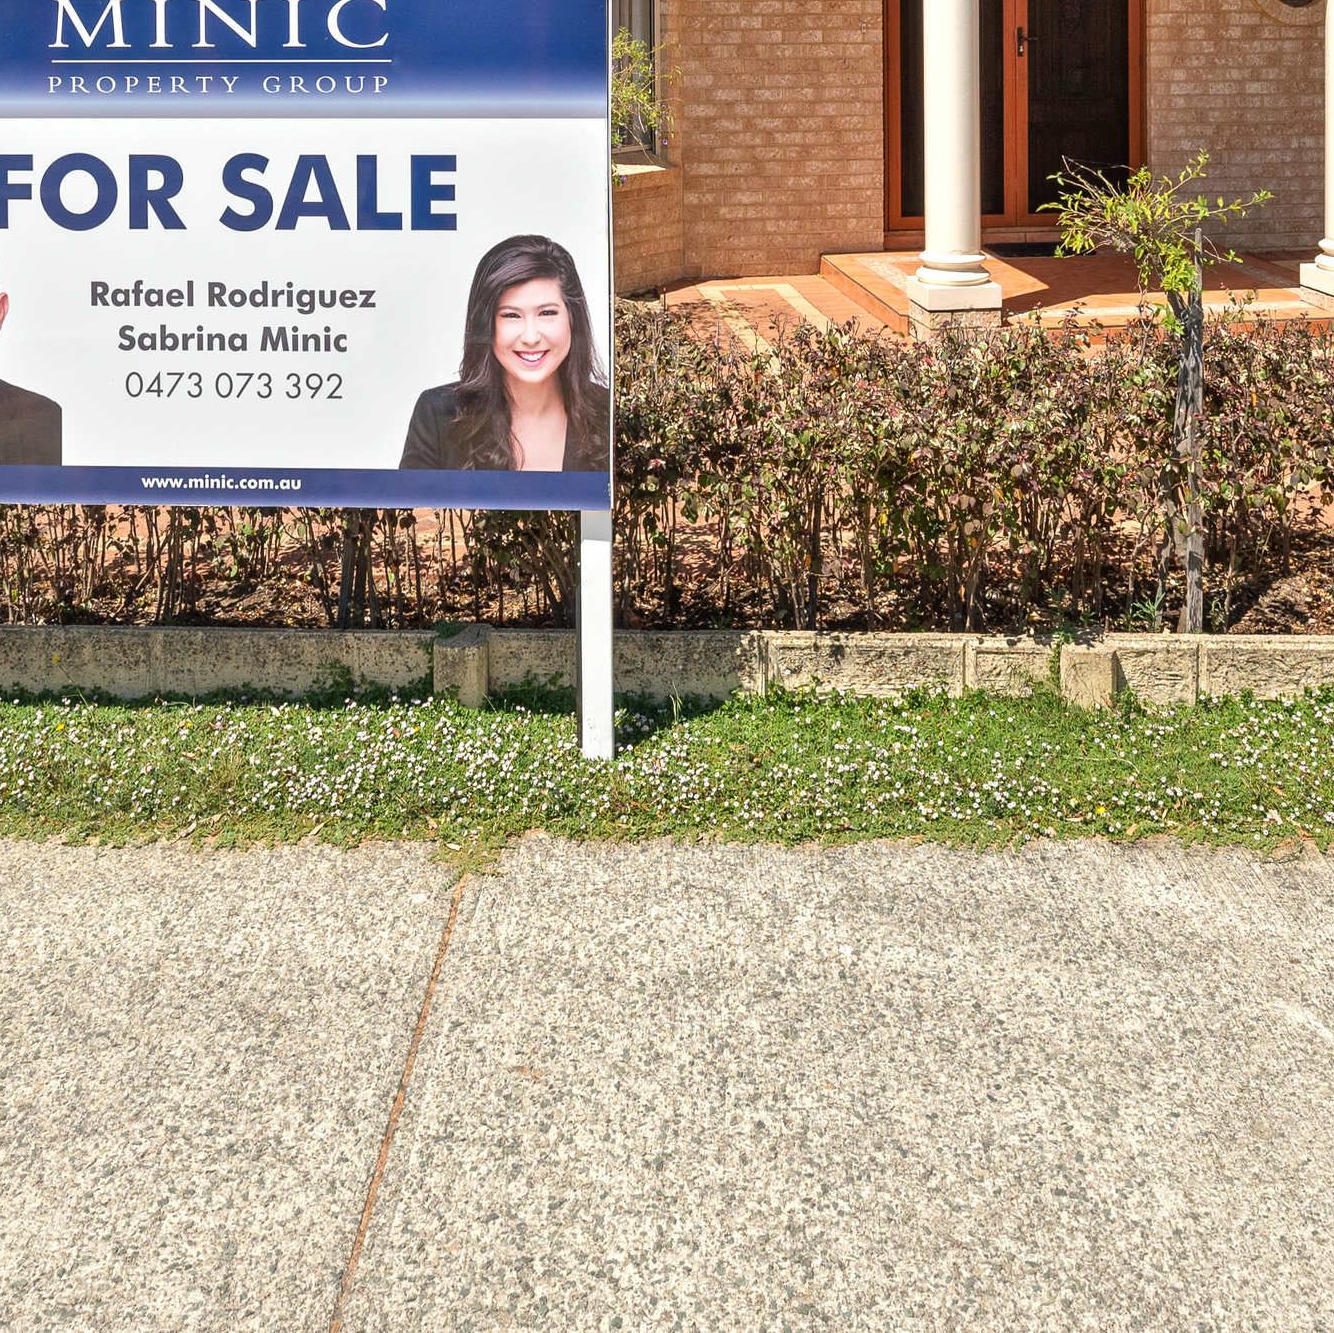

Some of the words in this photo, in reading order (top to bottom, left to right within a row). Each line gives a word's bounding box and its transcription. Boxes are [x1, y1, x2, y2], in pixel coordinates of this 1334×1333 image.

[47, 74, 240, 95] PROPERTY
[262, 74, 390, 94] GROUP
[219, 152, 458, 232] SALE
[90, 279, 194, 308] Rafael
[207, 280, 376, 315] Rodriguez
[117, 324, 249, 352] Sabrina
[260, 324, 349, 354] Minic
[125, 371, 203, 398] 0473
[214, 372, 273, 399] 073
[285, 372, 343, 399] 392
[141, 474, 302, 491] www.minic.com.au
